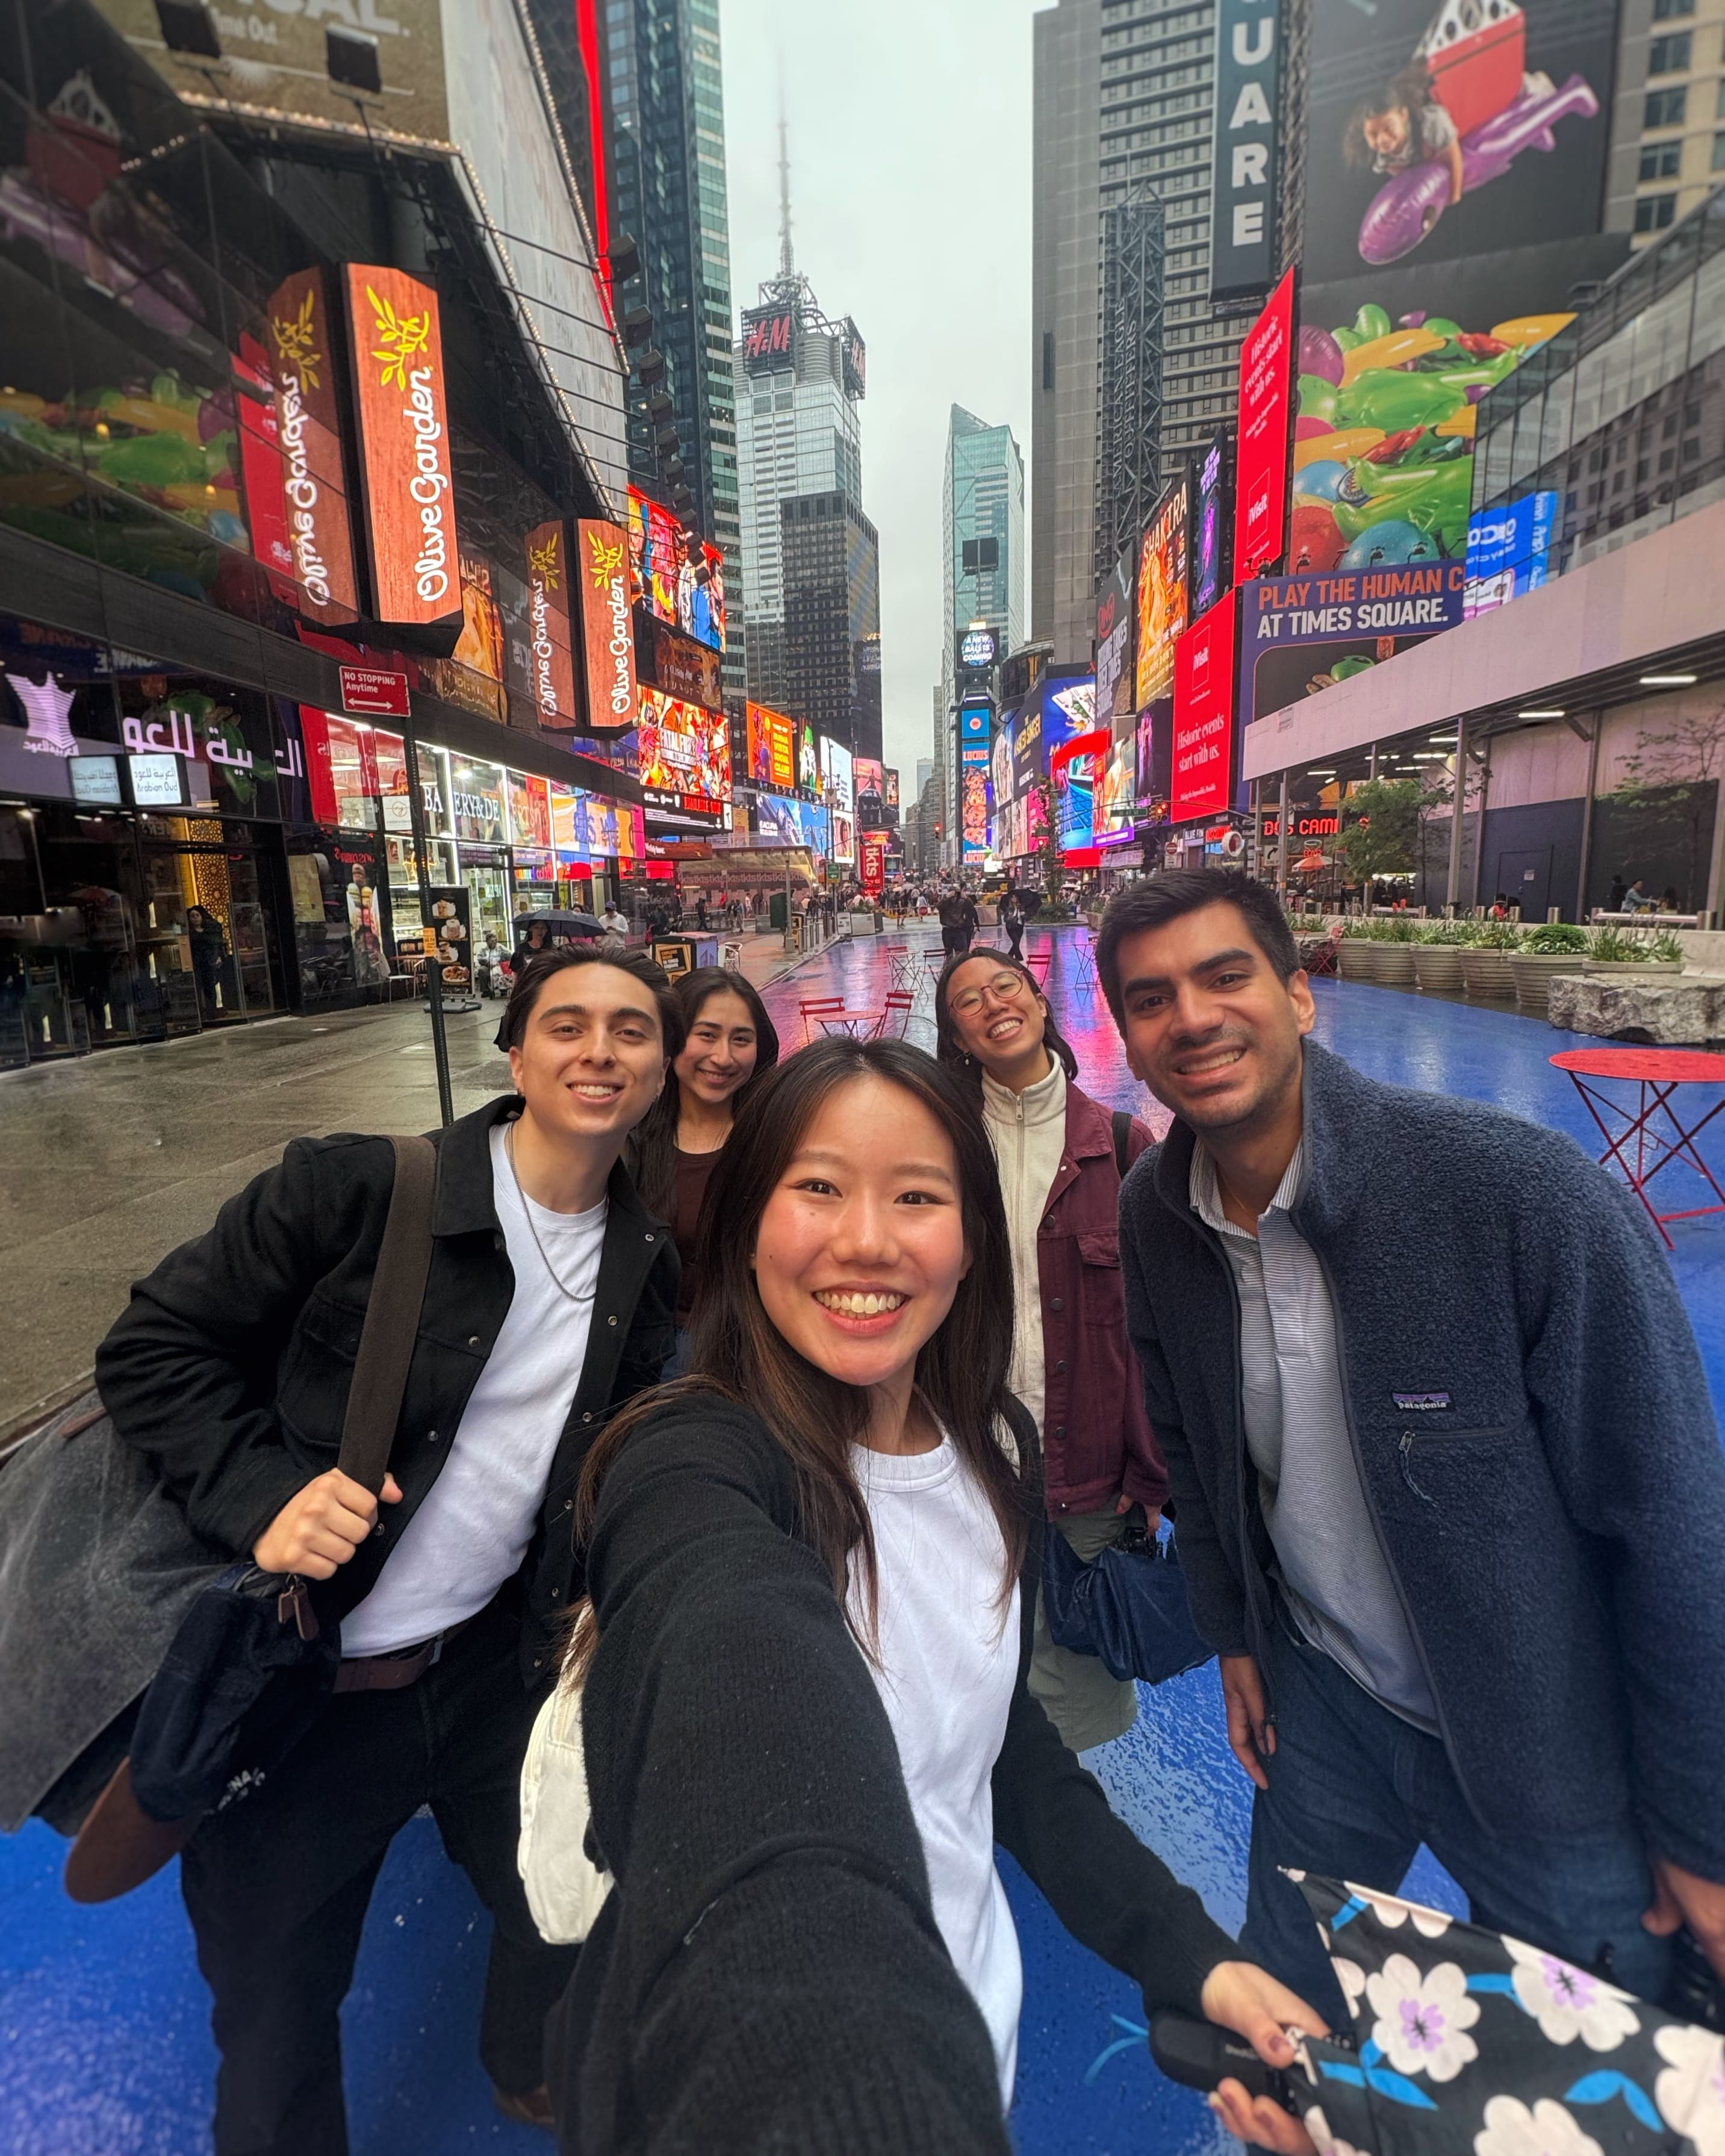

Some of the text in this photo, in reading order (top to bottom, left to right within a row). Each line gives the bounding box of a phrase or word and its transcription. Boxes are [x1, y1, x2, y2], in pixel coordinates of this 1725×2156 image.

[1229, 0, 1275, 246] UARE
[745, 315, 790, 359] H&M
[403, 365, 449, 603] Olive Garden
[1144, 482, 1187, 557] SHAKIRA
[1258, 566, 1465, 610] PLAY THE HUMAN C
[1257, 598, 1449, 639] AT TIMES SQUARE.
[607, 575, 632, 715] Olive Garden
[963, 653, 992, 662] COMING
[965, 644, 983, 653] BALL
[344, 671, 395, 686] NO STOPPING
[346, 682, 378, 693] Anytime
[660, 727, 680, 752] FATAL
[1177, 713, 1225, 750] Historic events
[963, 750, 988, 761] LUCIUS
[1178, 741, 1220, 773] start with us.
[137, 780, 179, 792] Arabian Oud
[423, 786, 476, 819] BAERY
[1185, 830, 1196, 840] BLUE
[865, 848, 880, 877] tkts
[964, 853, 985, 863] LUCIU
[1398, 1401, 1447, 1411] patagonia
